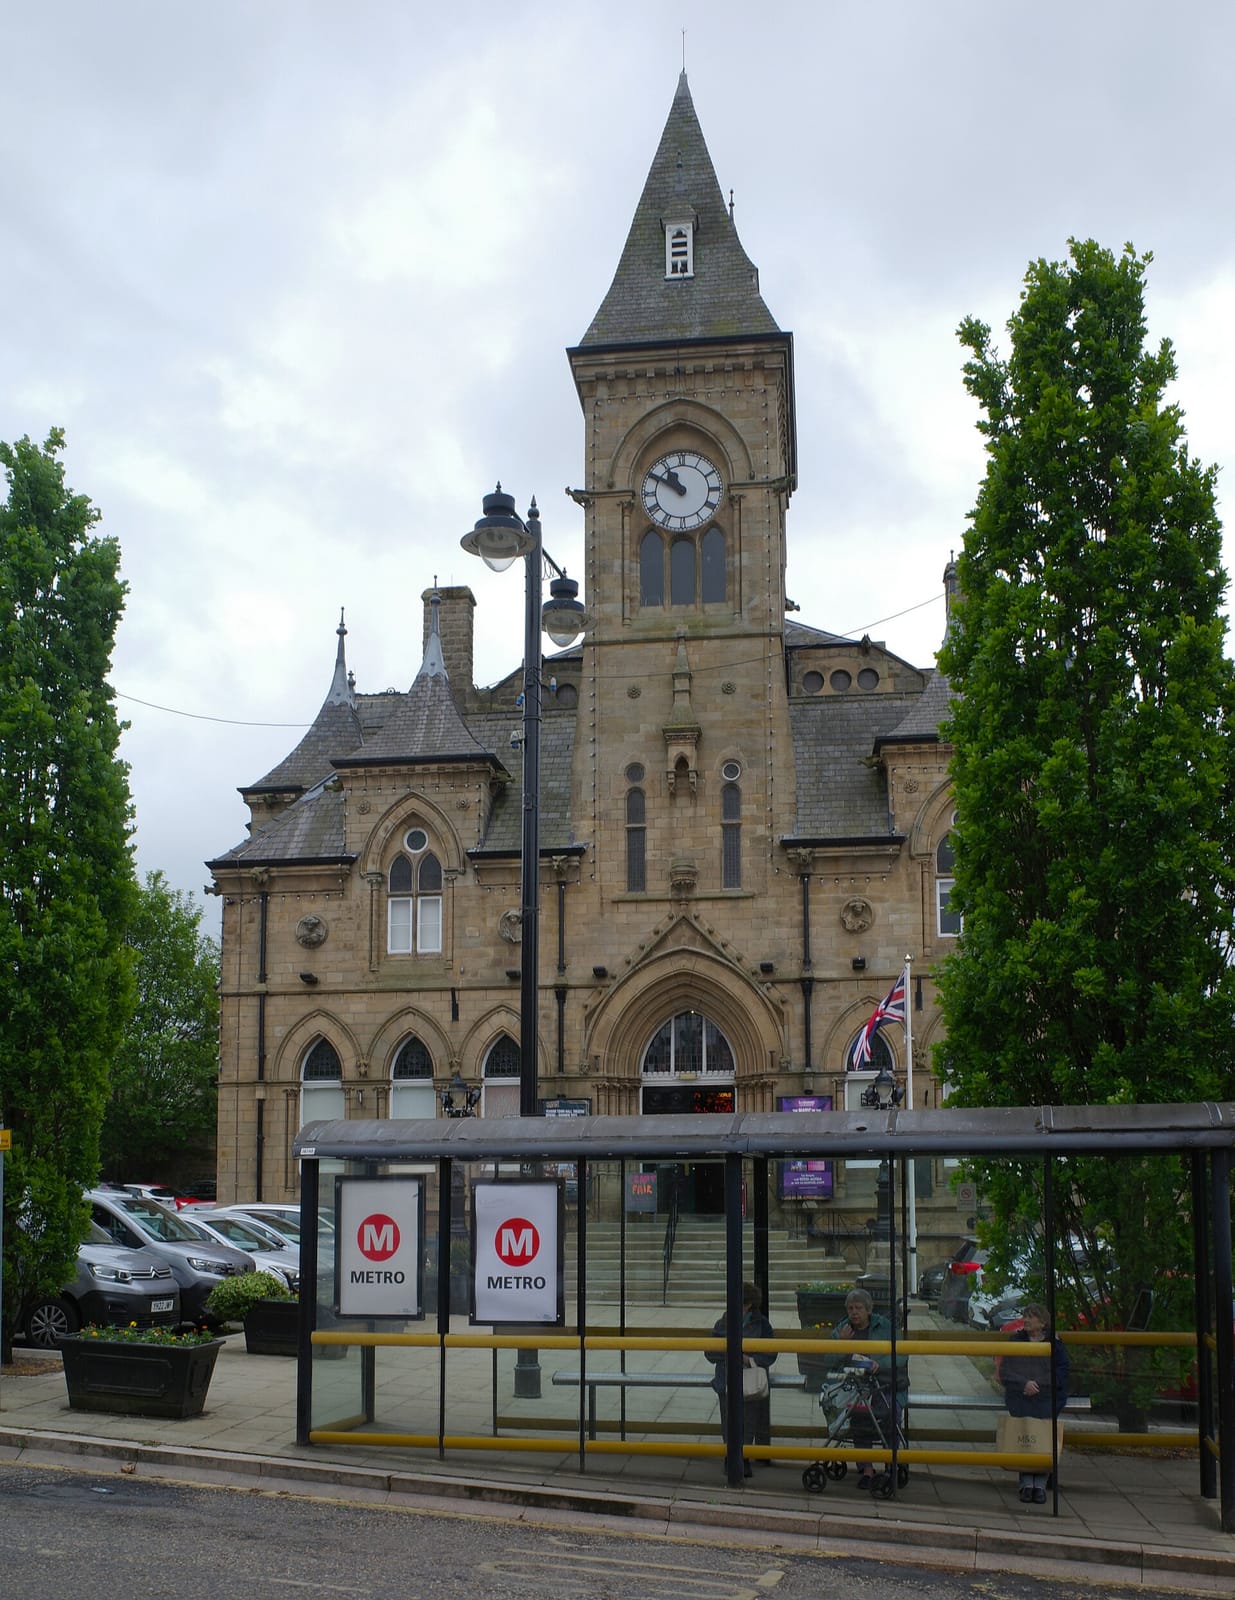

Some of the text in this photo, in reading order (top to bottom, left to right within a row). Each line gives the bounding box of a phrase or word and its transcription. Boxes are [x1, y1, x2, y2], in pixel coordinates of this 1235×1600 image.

[632, 1184, 653, 1195] FAIR
[363, 1224, 394, 1251] M
[501, 1228, 533, 1256] M
[350, 1271, 405, 1284] METRO
[487, 1276, 546, 1290] METRO
